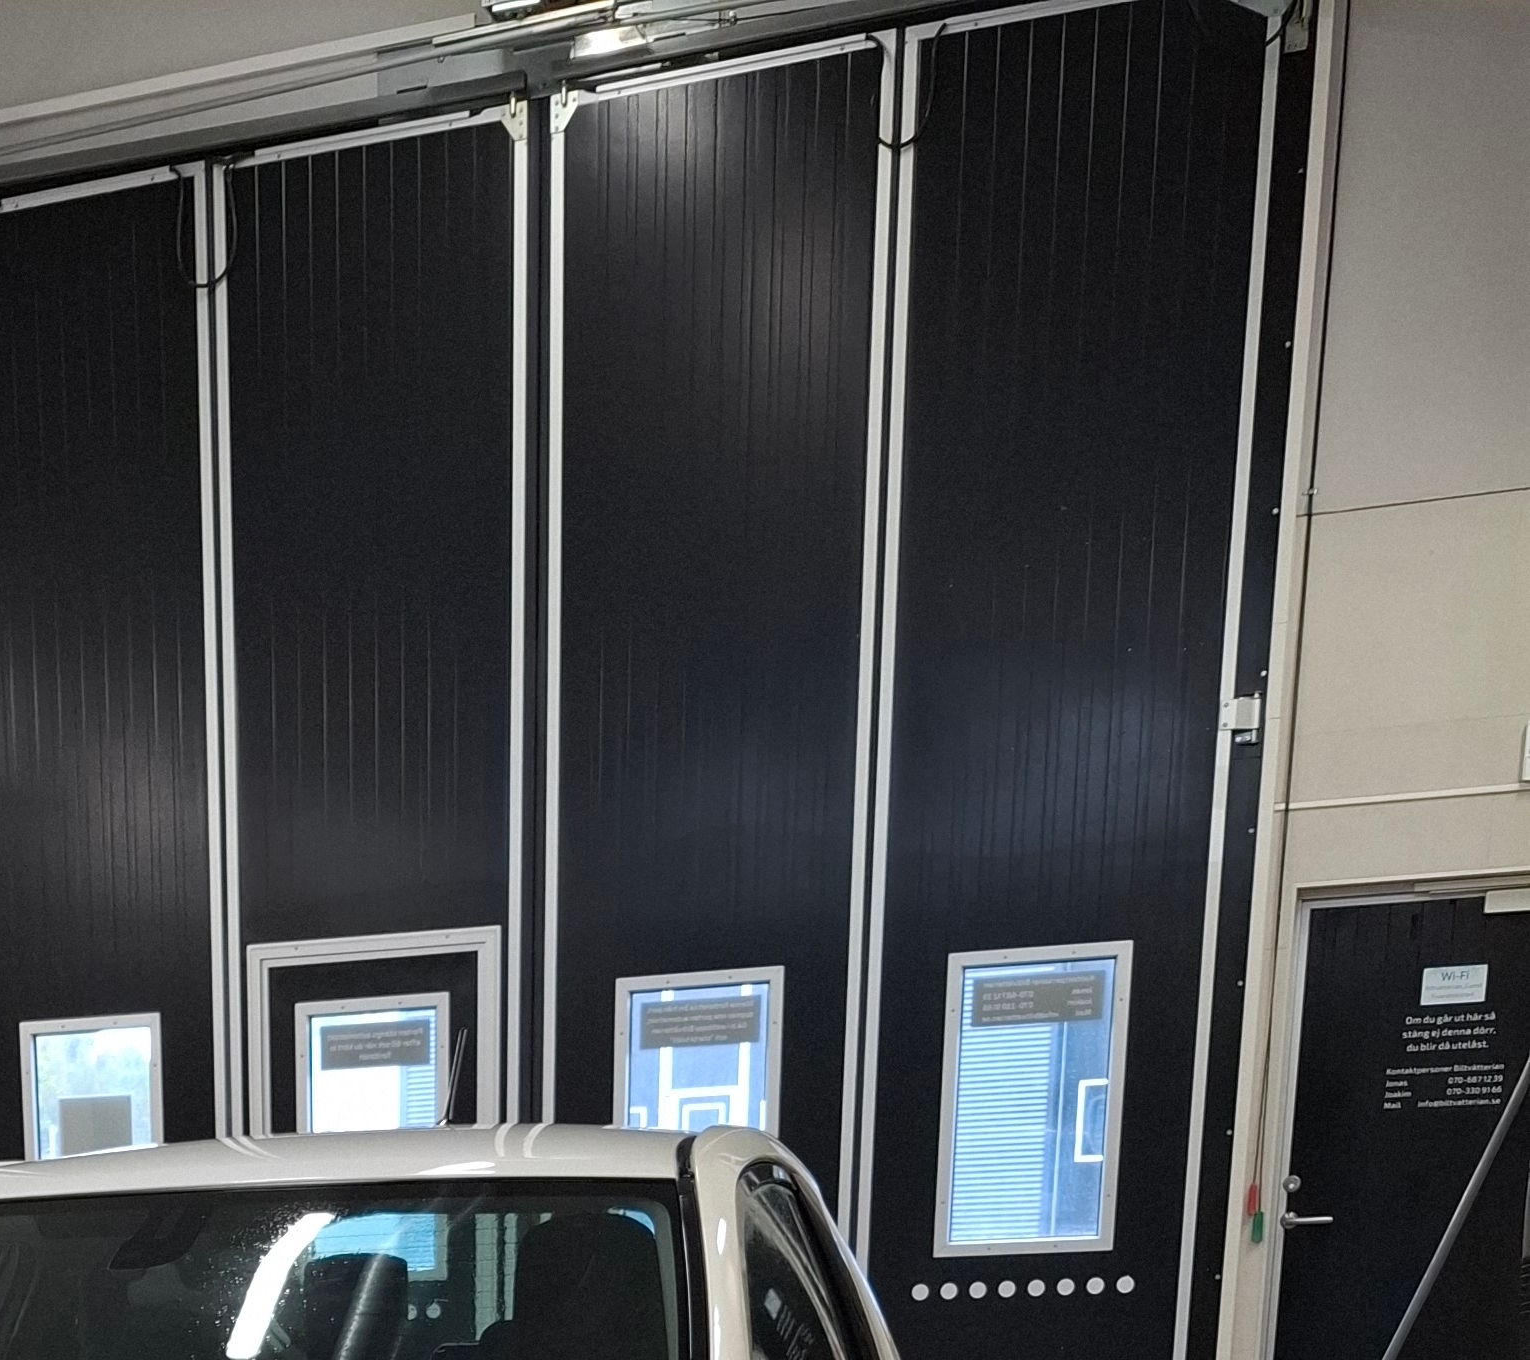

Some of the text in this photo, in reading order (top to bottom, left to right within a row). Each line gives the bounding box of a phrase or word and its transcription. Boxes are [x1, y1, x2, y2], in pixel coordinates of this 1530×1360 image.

[1441, 971, 1469, 981] Wi-Fi
[1405, 1016, 1422, 1025] Om
[1423, 1015, 1435, 1024] du
[1436, 1014, 1453, 1025] går
[1453, 1014, 1465, 1022] ut
[1484, 1011, 1496, 1020] så
[1402, 1029, 1430, 1039] stäng
[1431, 1028, 1441, 1039] ej
[1442, 1028, 1471, 1036] denna
[1406, 1040, 1489, 1052] du blir då utelåst.
[1386, 1066, 1452, 1075] Kontaktpersoner
